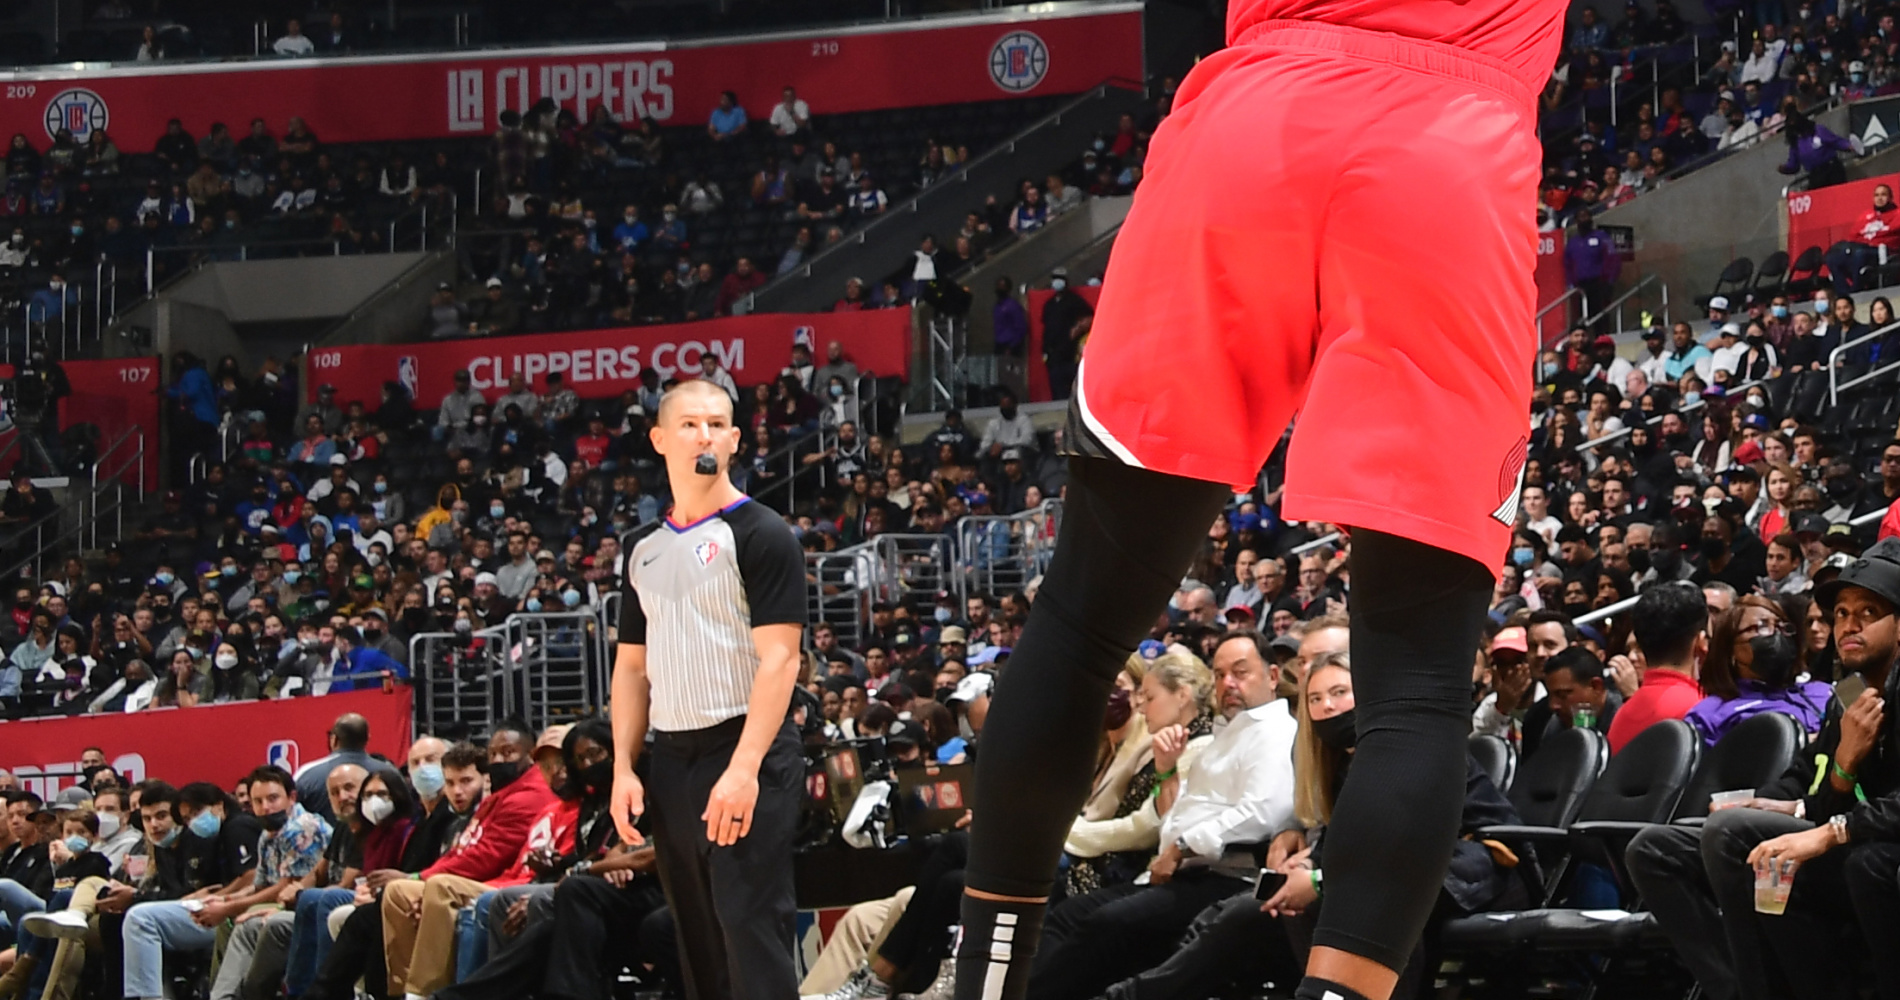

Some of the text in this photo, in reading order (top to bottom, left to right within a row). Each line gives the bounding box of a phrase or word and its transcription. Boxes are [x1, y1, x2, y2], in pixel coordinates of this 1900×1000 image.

[812, 43, 839, 56] 210
[7, 85, 36, 99] 209
[448, 59, 674, 131] LA CLIPPERS
[1789, 196, 1811, 214] 109
[313, 353, 341, 369] 108
[119, 367, 150, 384] 107
